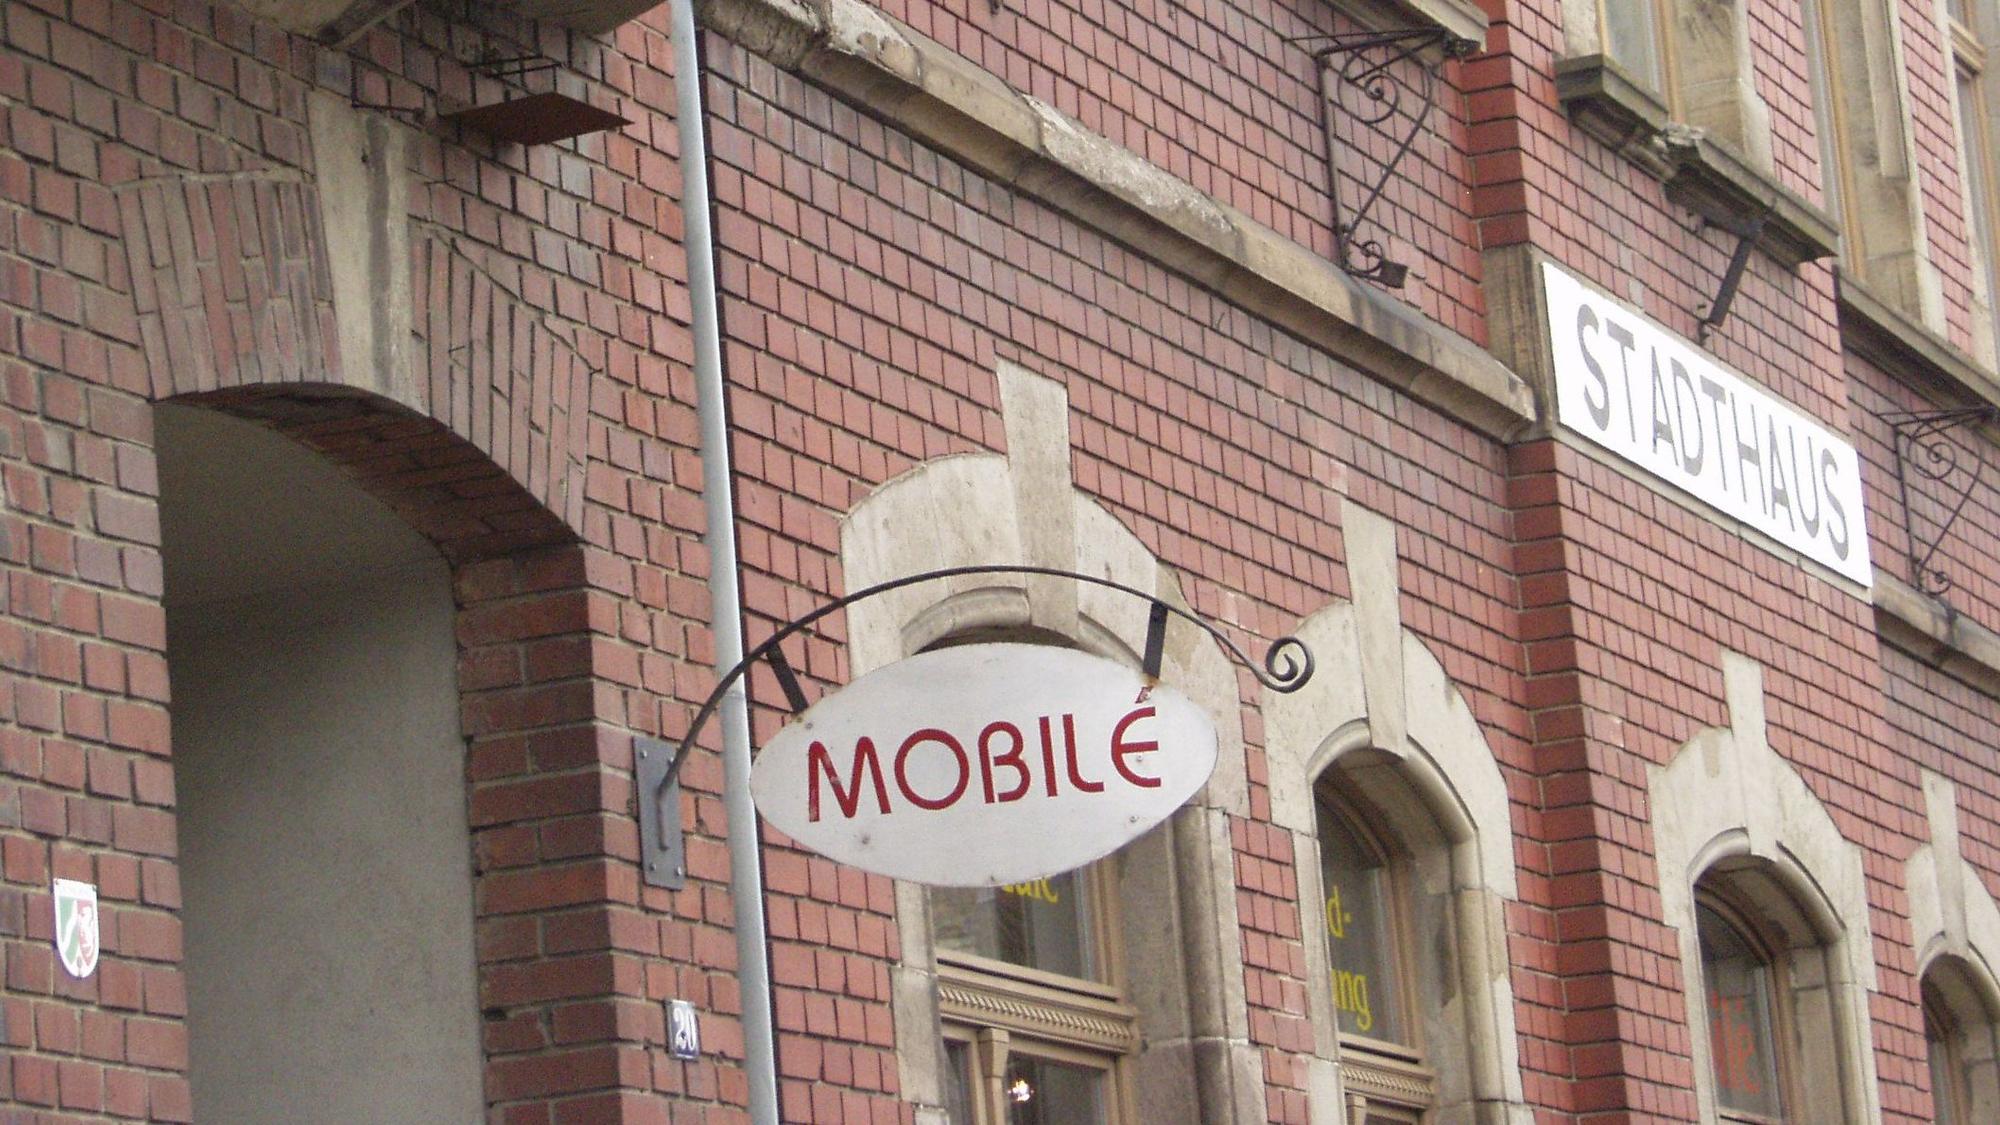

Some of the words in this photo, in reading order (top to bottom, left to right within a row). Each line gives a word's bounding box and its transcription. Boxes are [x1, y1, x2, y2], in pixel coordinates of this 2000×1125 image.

[1576, 303, 1850, 562] STADTHAUS
[808, 686, 1162, 822] MOBILÉ
[673, 1007, 697, 1051] 20
